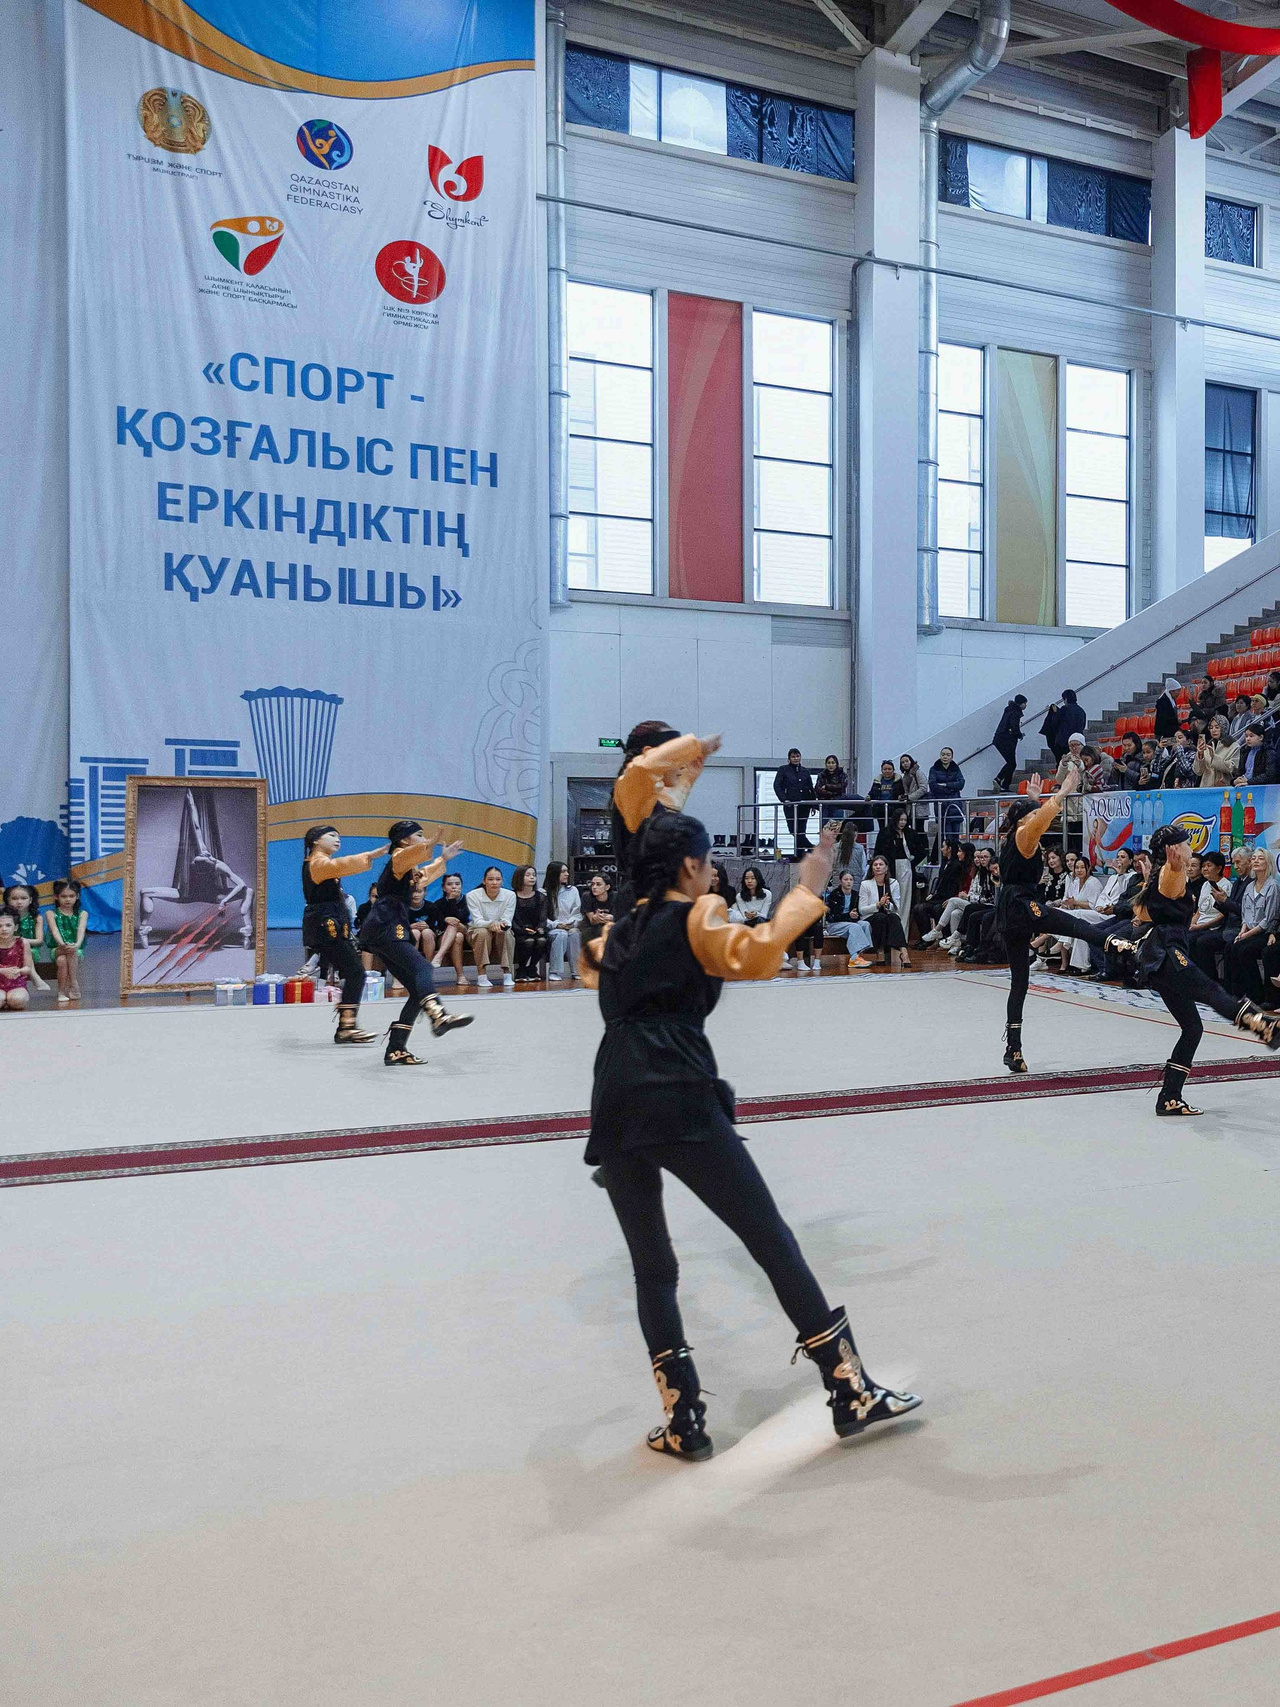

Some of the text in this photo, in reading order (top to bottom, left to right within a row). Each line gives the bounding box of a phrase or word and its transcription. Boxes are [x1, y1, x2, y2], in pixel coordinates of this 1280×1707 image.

[167, 161, 193, 172] ЖӘНЕ
[195, 167, 223, 178] СПОРТ
[290, 173, 359, 193] QAZAQSTAN
[289, 184, 361, 204] GIMNASTIKA
[286, 194, 364, 215] FEDERACIASY
[204, 275, 243, 286] ШЫМКЕНТ
[211, 283, 232, 291] ДЕНЕ
[222, 292, 246, 301] СПОРТ
[202, 352, 394, 410] «СПОРТ
[116, 405, 498, 488] ҚОЗҒАЛЫС ПЕН
[157, 481, 470, 558] ЕРКІНДІКТІҢ
[164, 552, 463, 612] ҚУАНЫШЫ»
[1089, 796, 1131, 822] AQUAS
